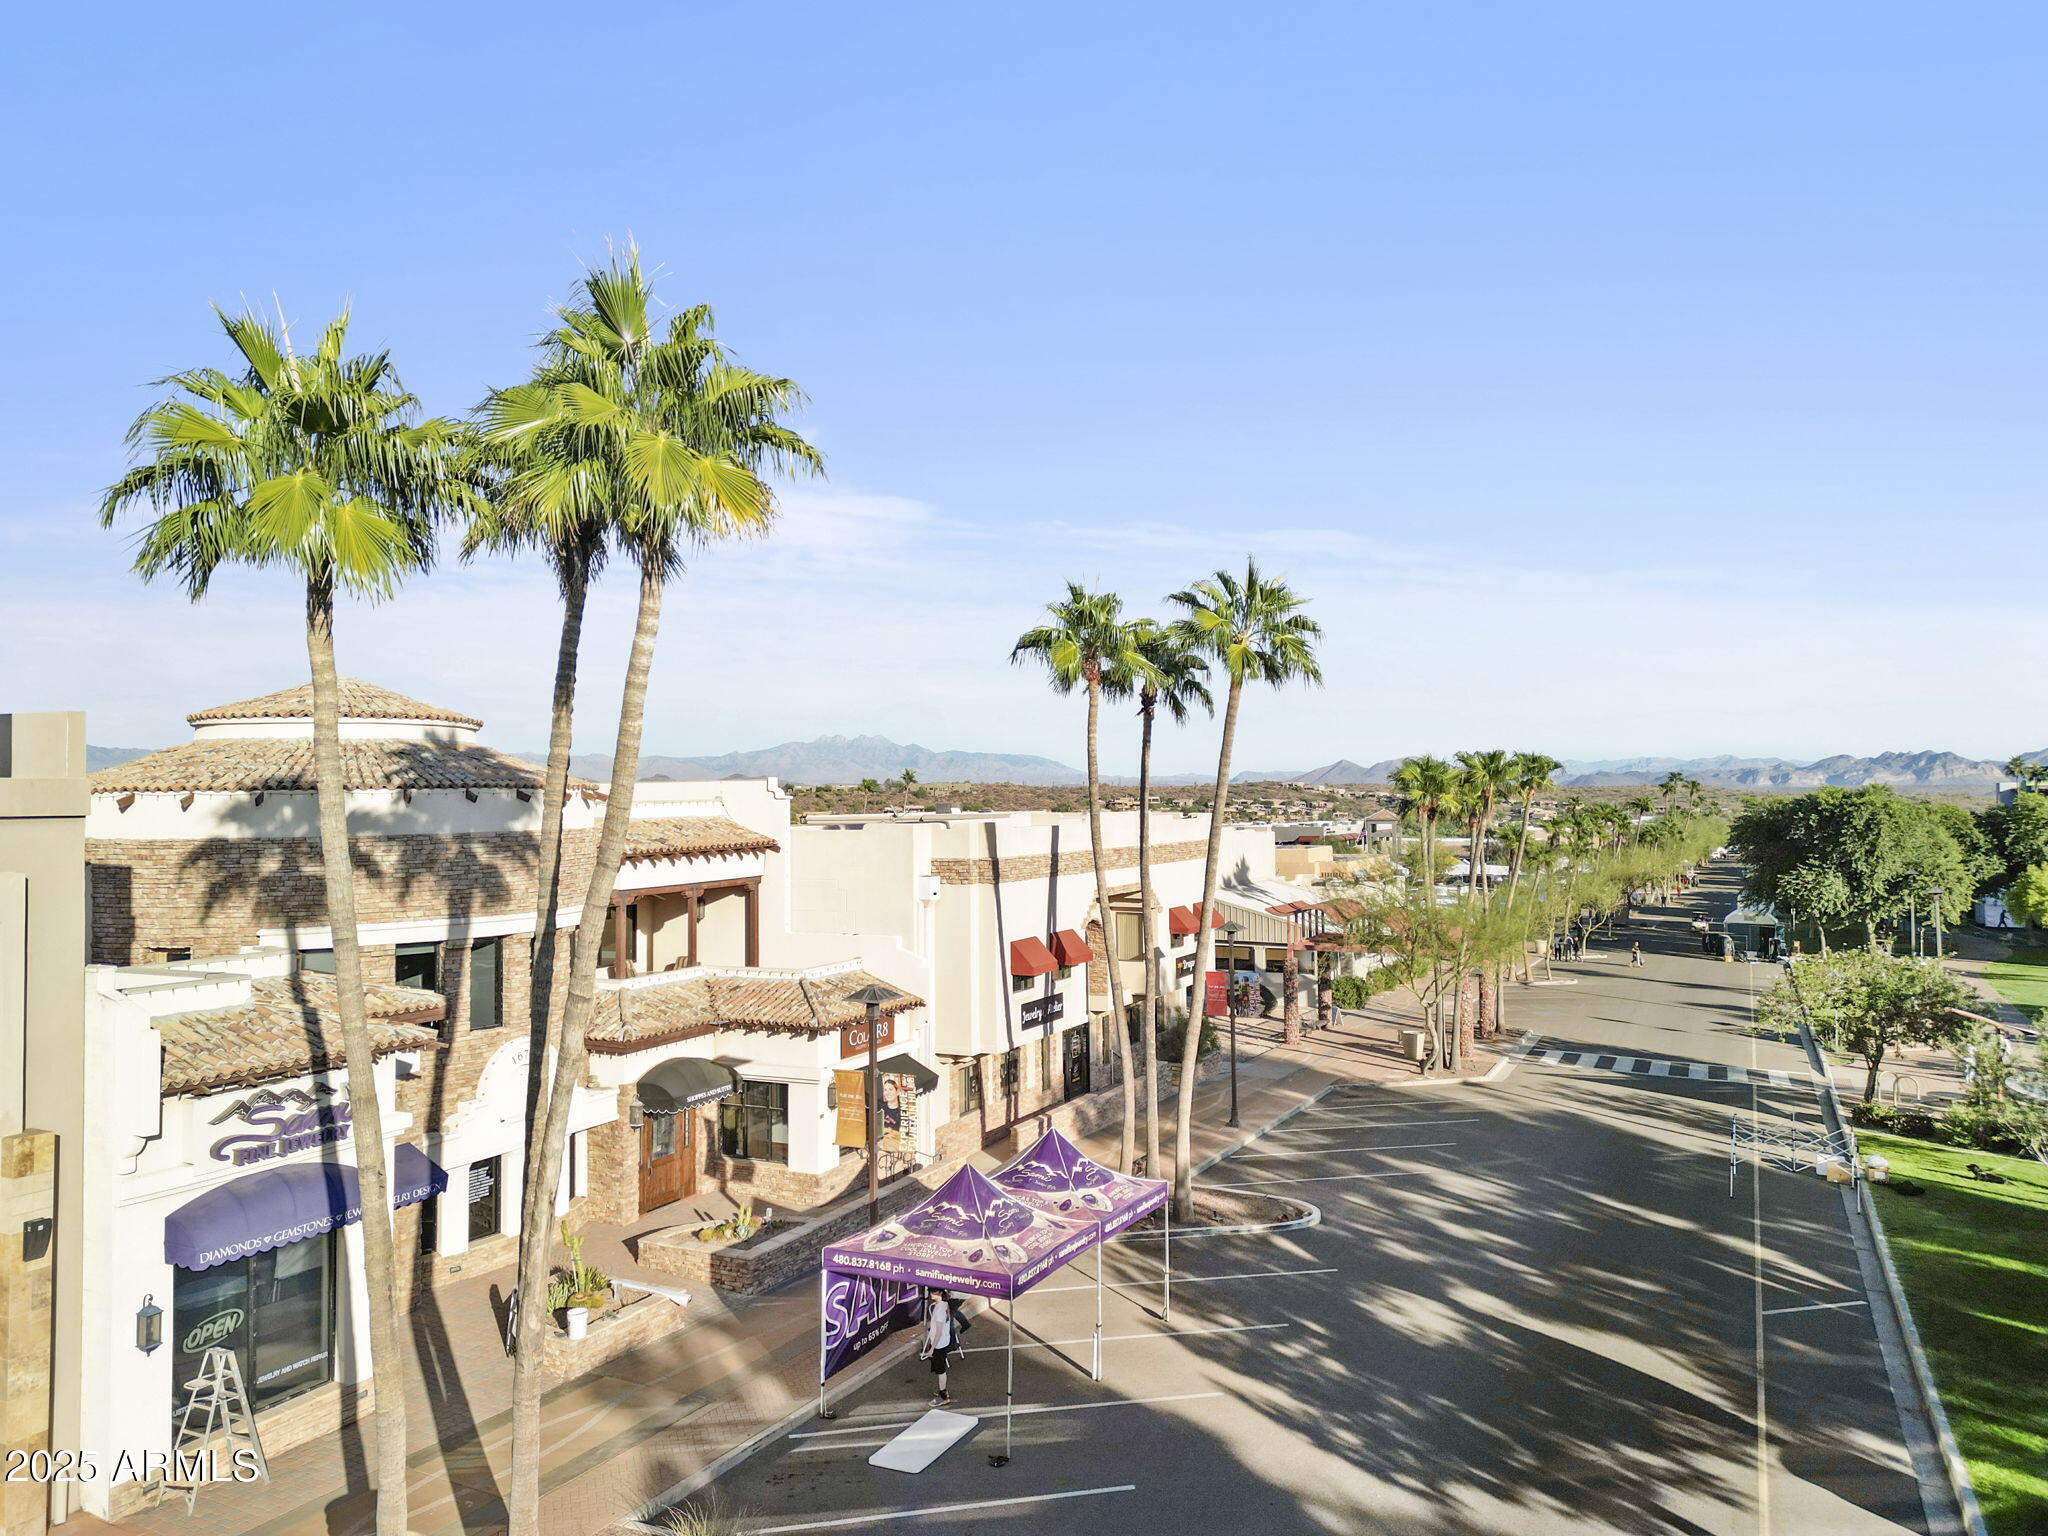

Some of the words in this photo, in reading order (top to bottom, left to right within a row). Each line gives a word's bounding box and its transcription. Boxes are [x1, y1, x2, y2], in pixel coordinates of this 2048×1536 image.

[1022, 1006, 1042, 1024] Jewelry
[686, 1091, 706, 1103] SHOPPES
[706, 1088, 716, 1097] AND
[715, 1084, 732, 1094] SUITES
[900, 1089, 909, 1151] EXPERIENCE
[907, 1104, 918, 1152] FOUNTAIN
[233, 1142, 278, 1166] FINE
[278, 1124, 351, 1157] JEWELRY
[412, 1182, 442, 1198] DESIGN
[923, 1213, 964, 1227] Sami
[200, 1236, 262, 1264] DIAMONDS
[273, 1216, 333, 1242] GEMSTONES
[832, 1254, 891, 1272] 480.837.8168
[892, 1264, 905, 1275] ph
[914, 1268, 1001, 1291] samifinejewelry.com
[826, 1275, 919, 1350] SALE
[186, 1313, 238, 1349] OPEN
[853, 1340, 862, 1351] up
[861, 1336, 868, 1346] to
[868, 1328, 881, 1342] 65%
[880, 1321, 890, 1334] OFF
[256, 1368, 282, 1385] JEWELRY
[281, 1365, 293, 1375] AND
[292, 1357, 310, 1370] WATCH
